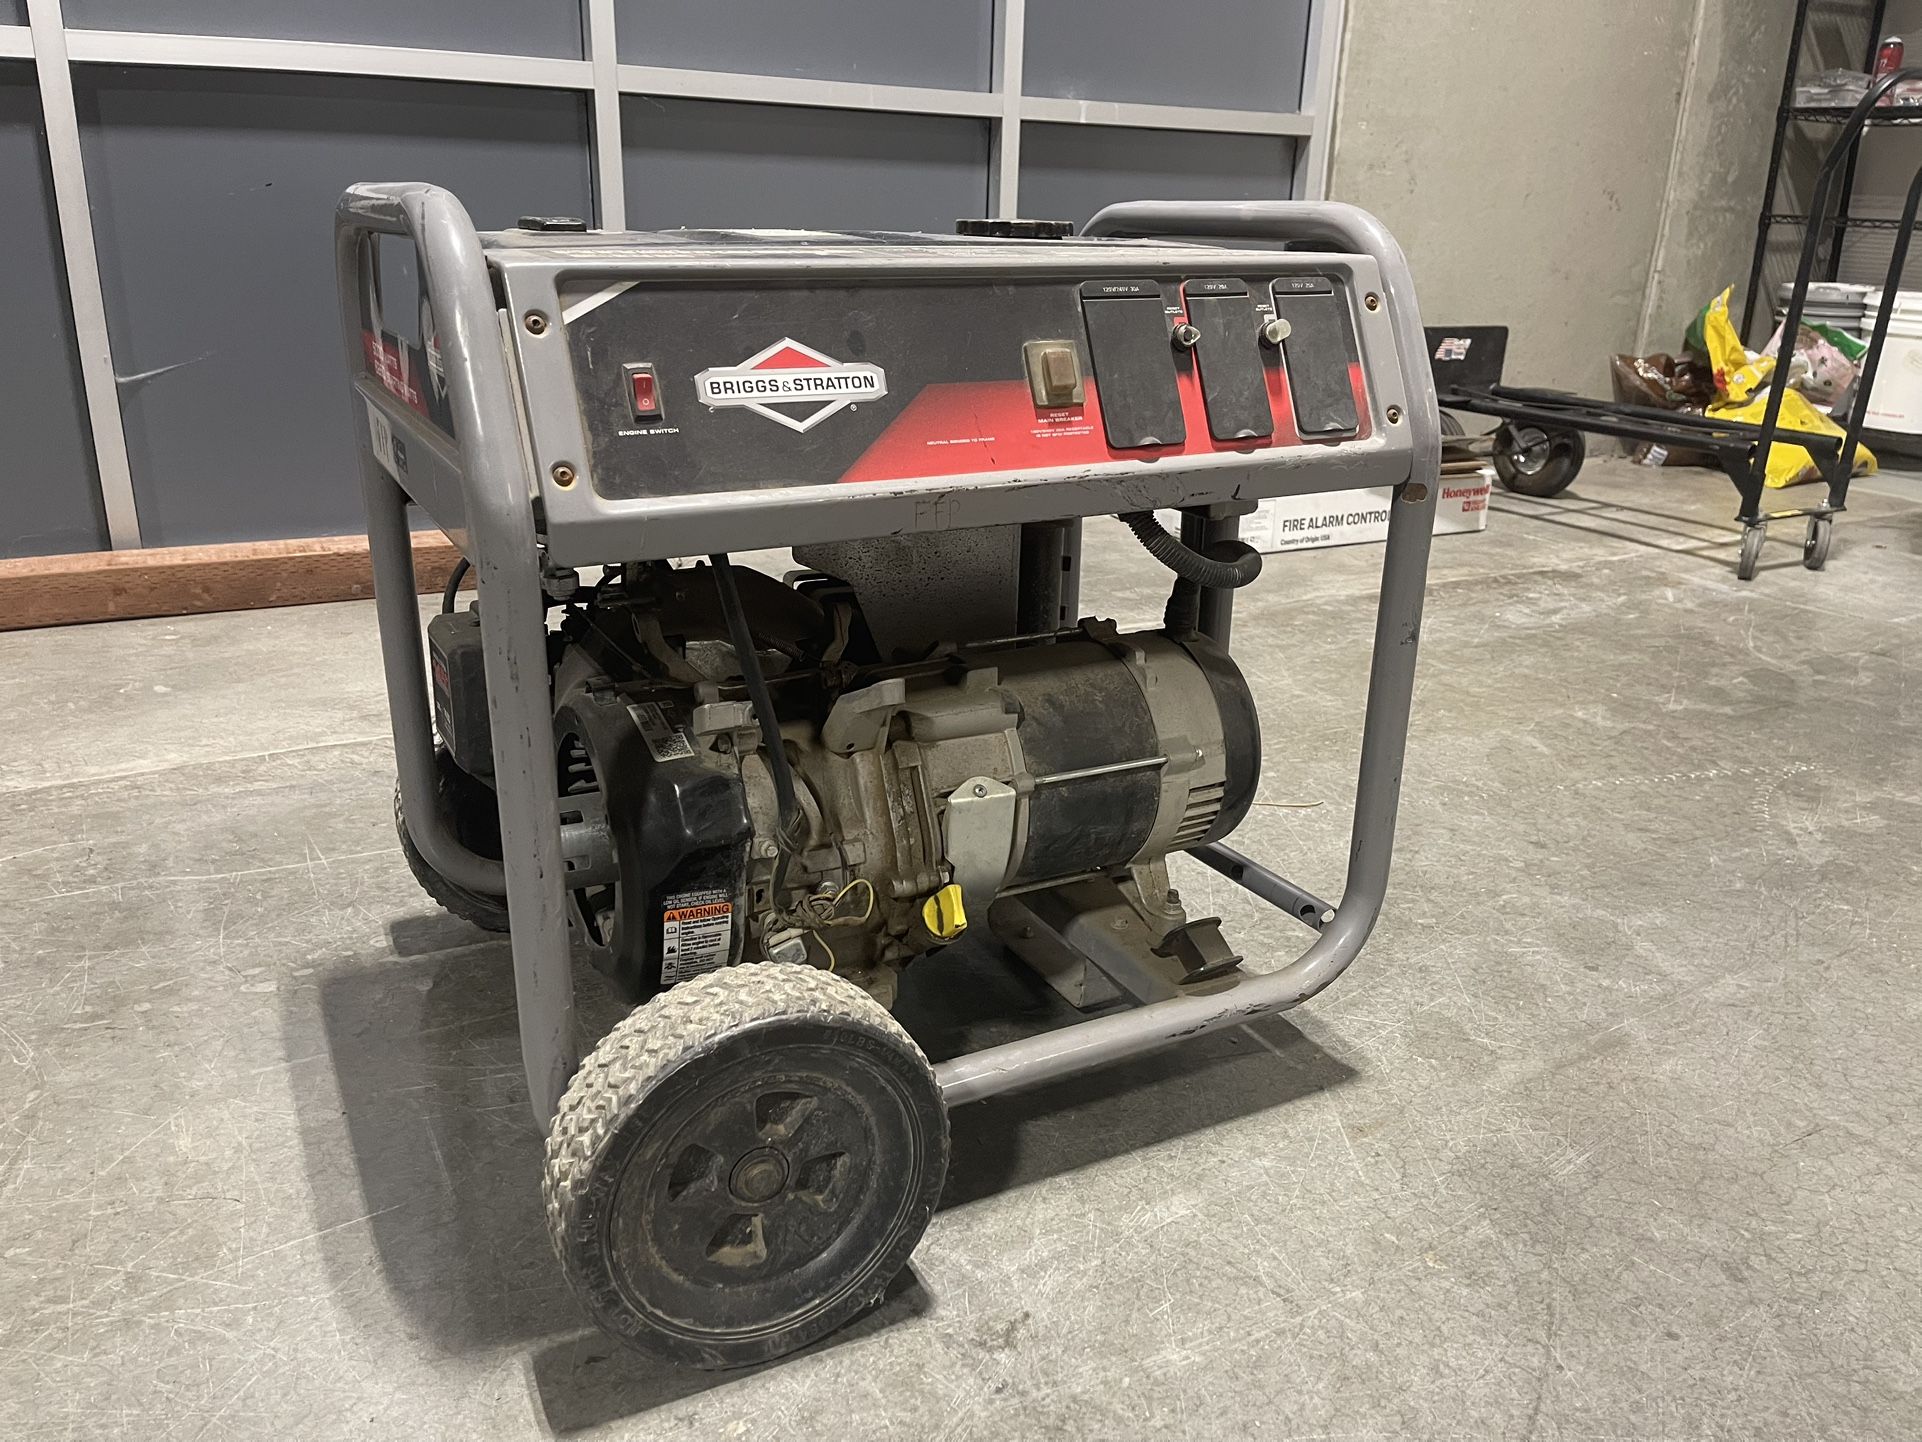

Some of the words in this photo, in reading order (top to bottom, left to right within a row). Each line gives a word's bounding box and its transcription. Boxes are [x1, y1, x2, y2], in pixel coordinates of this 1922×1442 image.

[710, 380, 780, 394] BRIGGS
[782, 381, 792, 392] &
[794, 376, 875, 391] STRATTON
[1442, 484, 1491, 499] Honeywell
[1282, 518, 1306, 532] FIRE
[1307, 514, 1345, 530] ALARM
[1280, 538, 1299, 546] Country
[678, 904, 729, 919] WARNING
